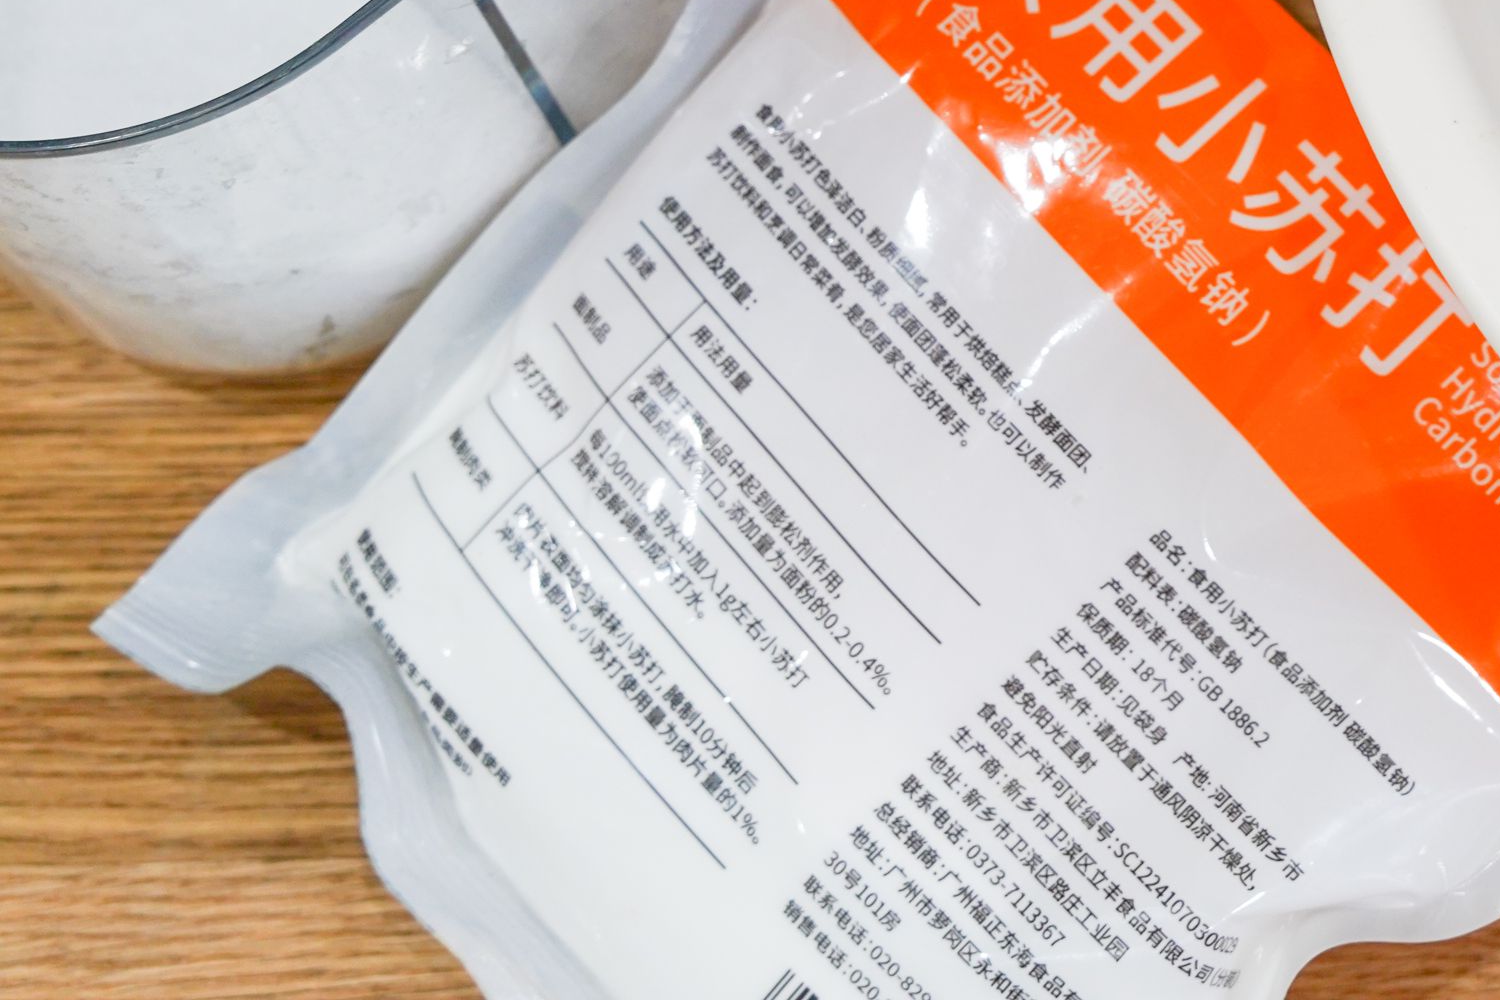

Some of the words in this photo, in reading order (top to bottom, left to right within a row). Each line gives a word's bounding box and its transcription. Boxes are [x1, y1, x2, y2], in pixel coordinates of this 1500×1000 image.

[624, 243, 656, 280] 用途
[659, 196, 757, 311] 使用方法及用量：
[706, 147, 970, 447] 苏打饮料和烹调日常菜肴，是您居家生活好帮手。
[572, 293, 611, 344] 面制品
[690, 325, 753, 394] 用法用量
[514, 354, 568, 420] 苏打饮料
[590, 429, 810, 688] 每100ml用水中加入1g左右小苏打
[1124, 551, 1243, 674] 配料表：碳酸氢钠
[1099, 578, 1223, 702] 产品标准代号：GB
[1219, 698, 1270, 748] 1886.2
[1149, 529, 1350, 727] 品名：食用小苏打（食品添加剂
[1001, 674, 1098, 774] 避免阳光直射
[824, 851, 901, 932] 30号101房
[900, 774, 1066, 946] 联系电话：0373-7113367
[926, 750, 1130, 962] 地址：新乡市卫滨区路庄工业园
